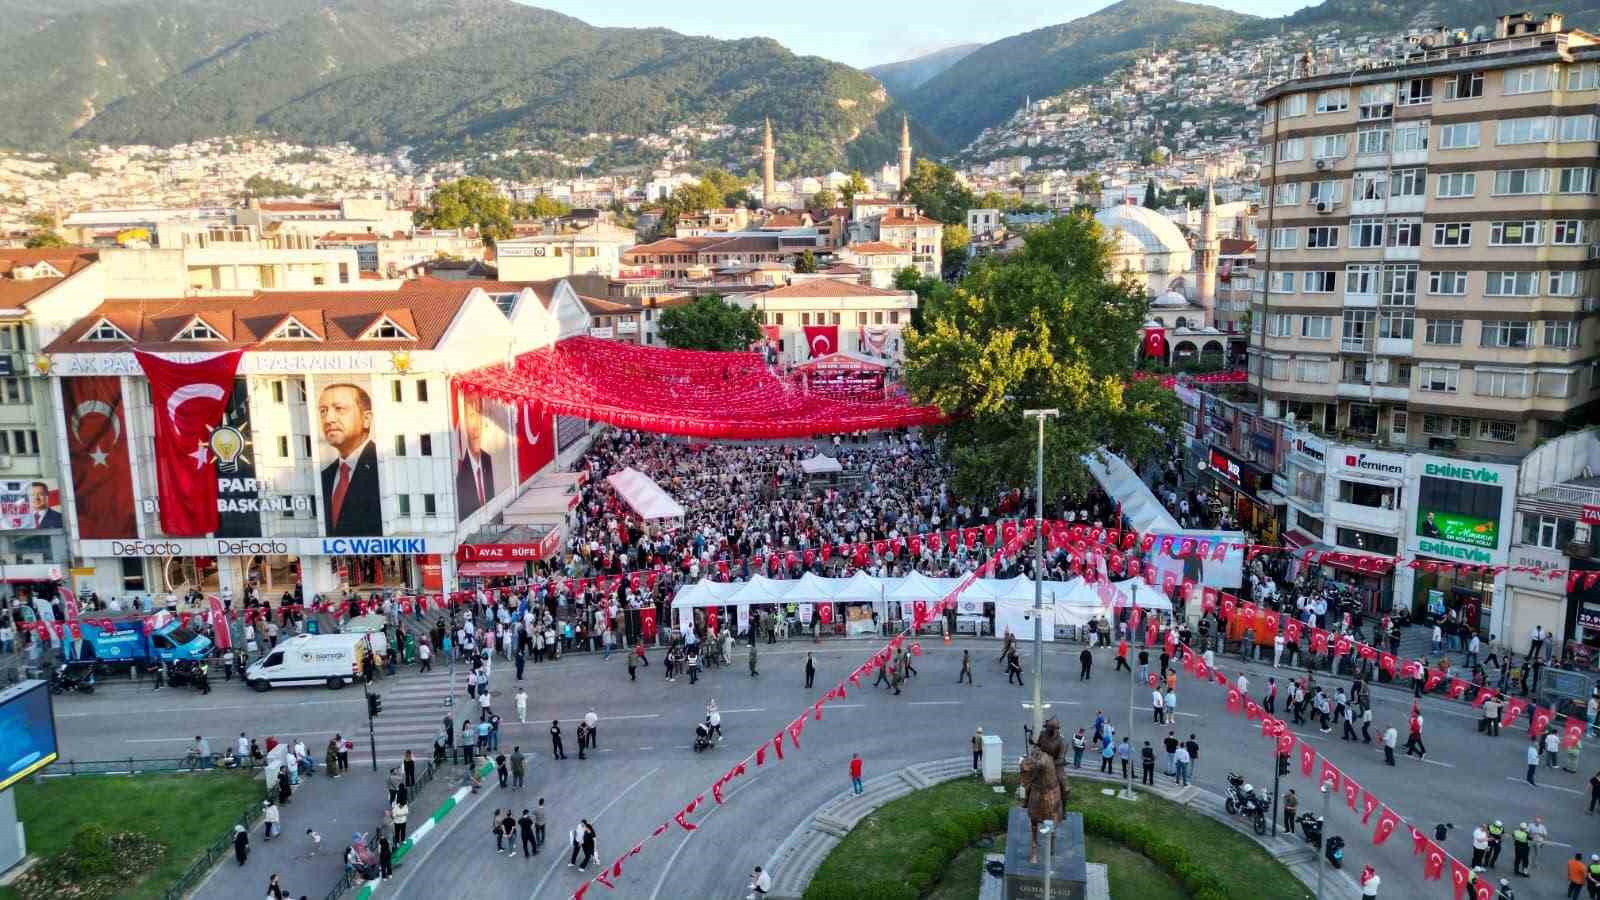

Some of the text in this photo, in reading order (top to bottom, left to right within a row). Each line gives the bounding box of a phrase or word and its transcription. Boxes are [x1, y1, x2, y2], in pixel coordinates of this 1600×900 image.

[1358, 457, 1403, 474] feminen
[1425, 462, 1499, 484] EMİNEVİM
[217, 496, 311, 513] BAŞKANLIĞI
[112, 539, 288, 556] DeFacto DeFacto
[323, 539, 347, 554] LC
[1419, 540, 1492, 564] EMİNEVİM
